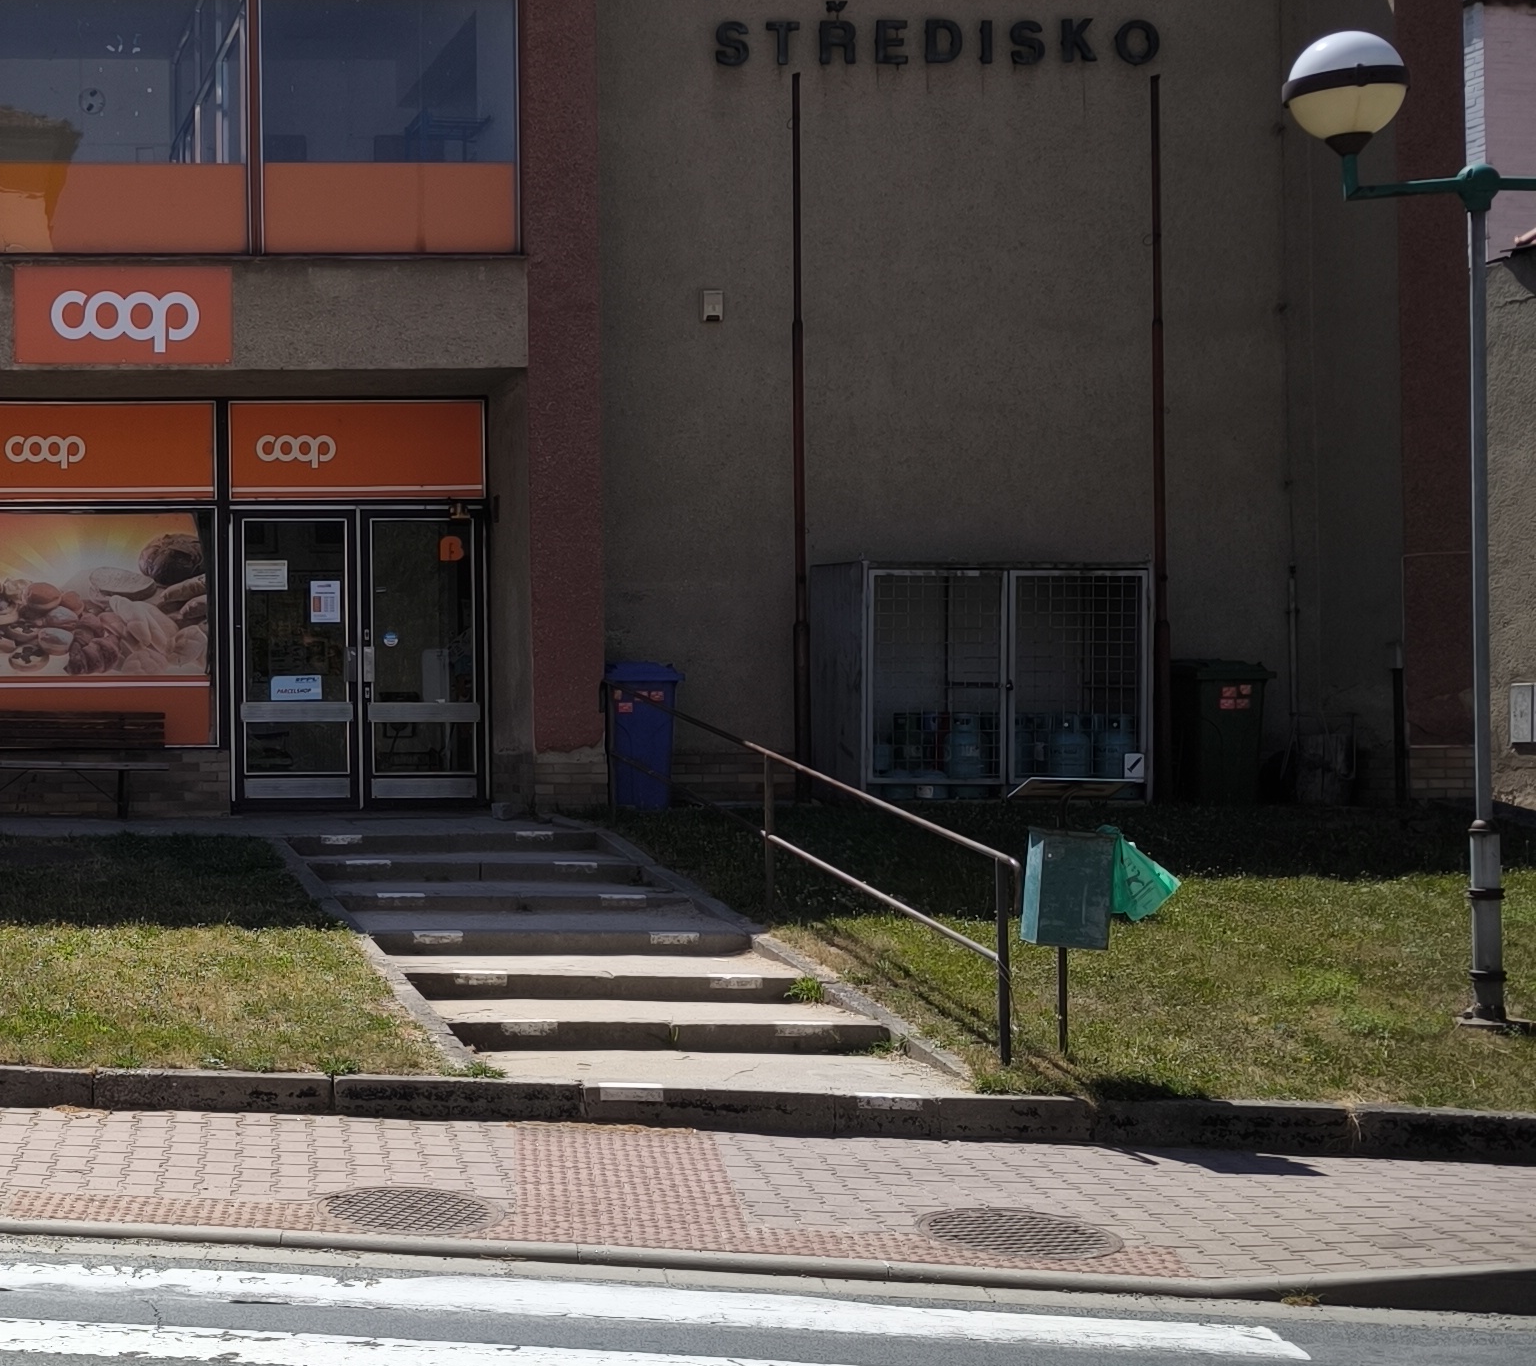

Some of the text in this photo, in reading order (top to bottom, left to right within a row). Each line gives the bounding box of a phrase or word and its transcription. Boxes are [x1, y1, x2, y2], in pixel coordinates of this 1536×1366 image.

[715, 0, 1161, 66] STŘEDISKO
[50, 290, 200, 353] coop
[5, 435, 86, 469] coop
[256, 434, 337, 469] coop
